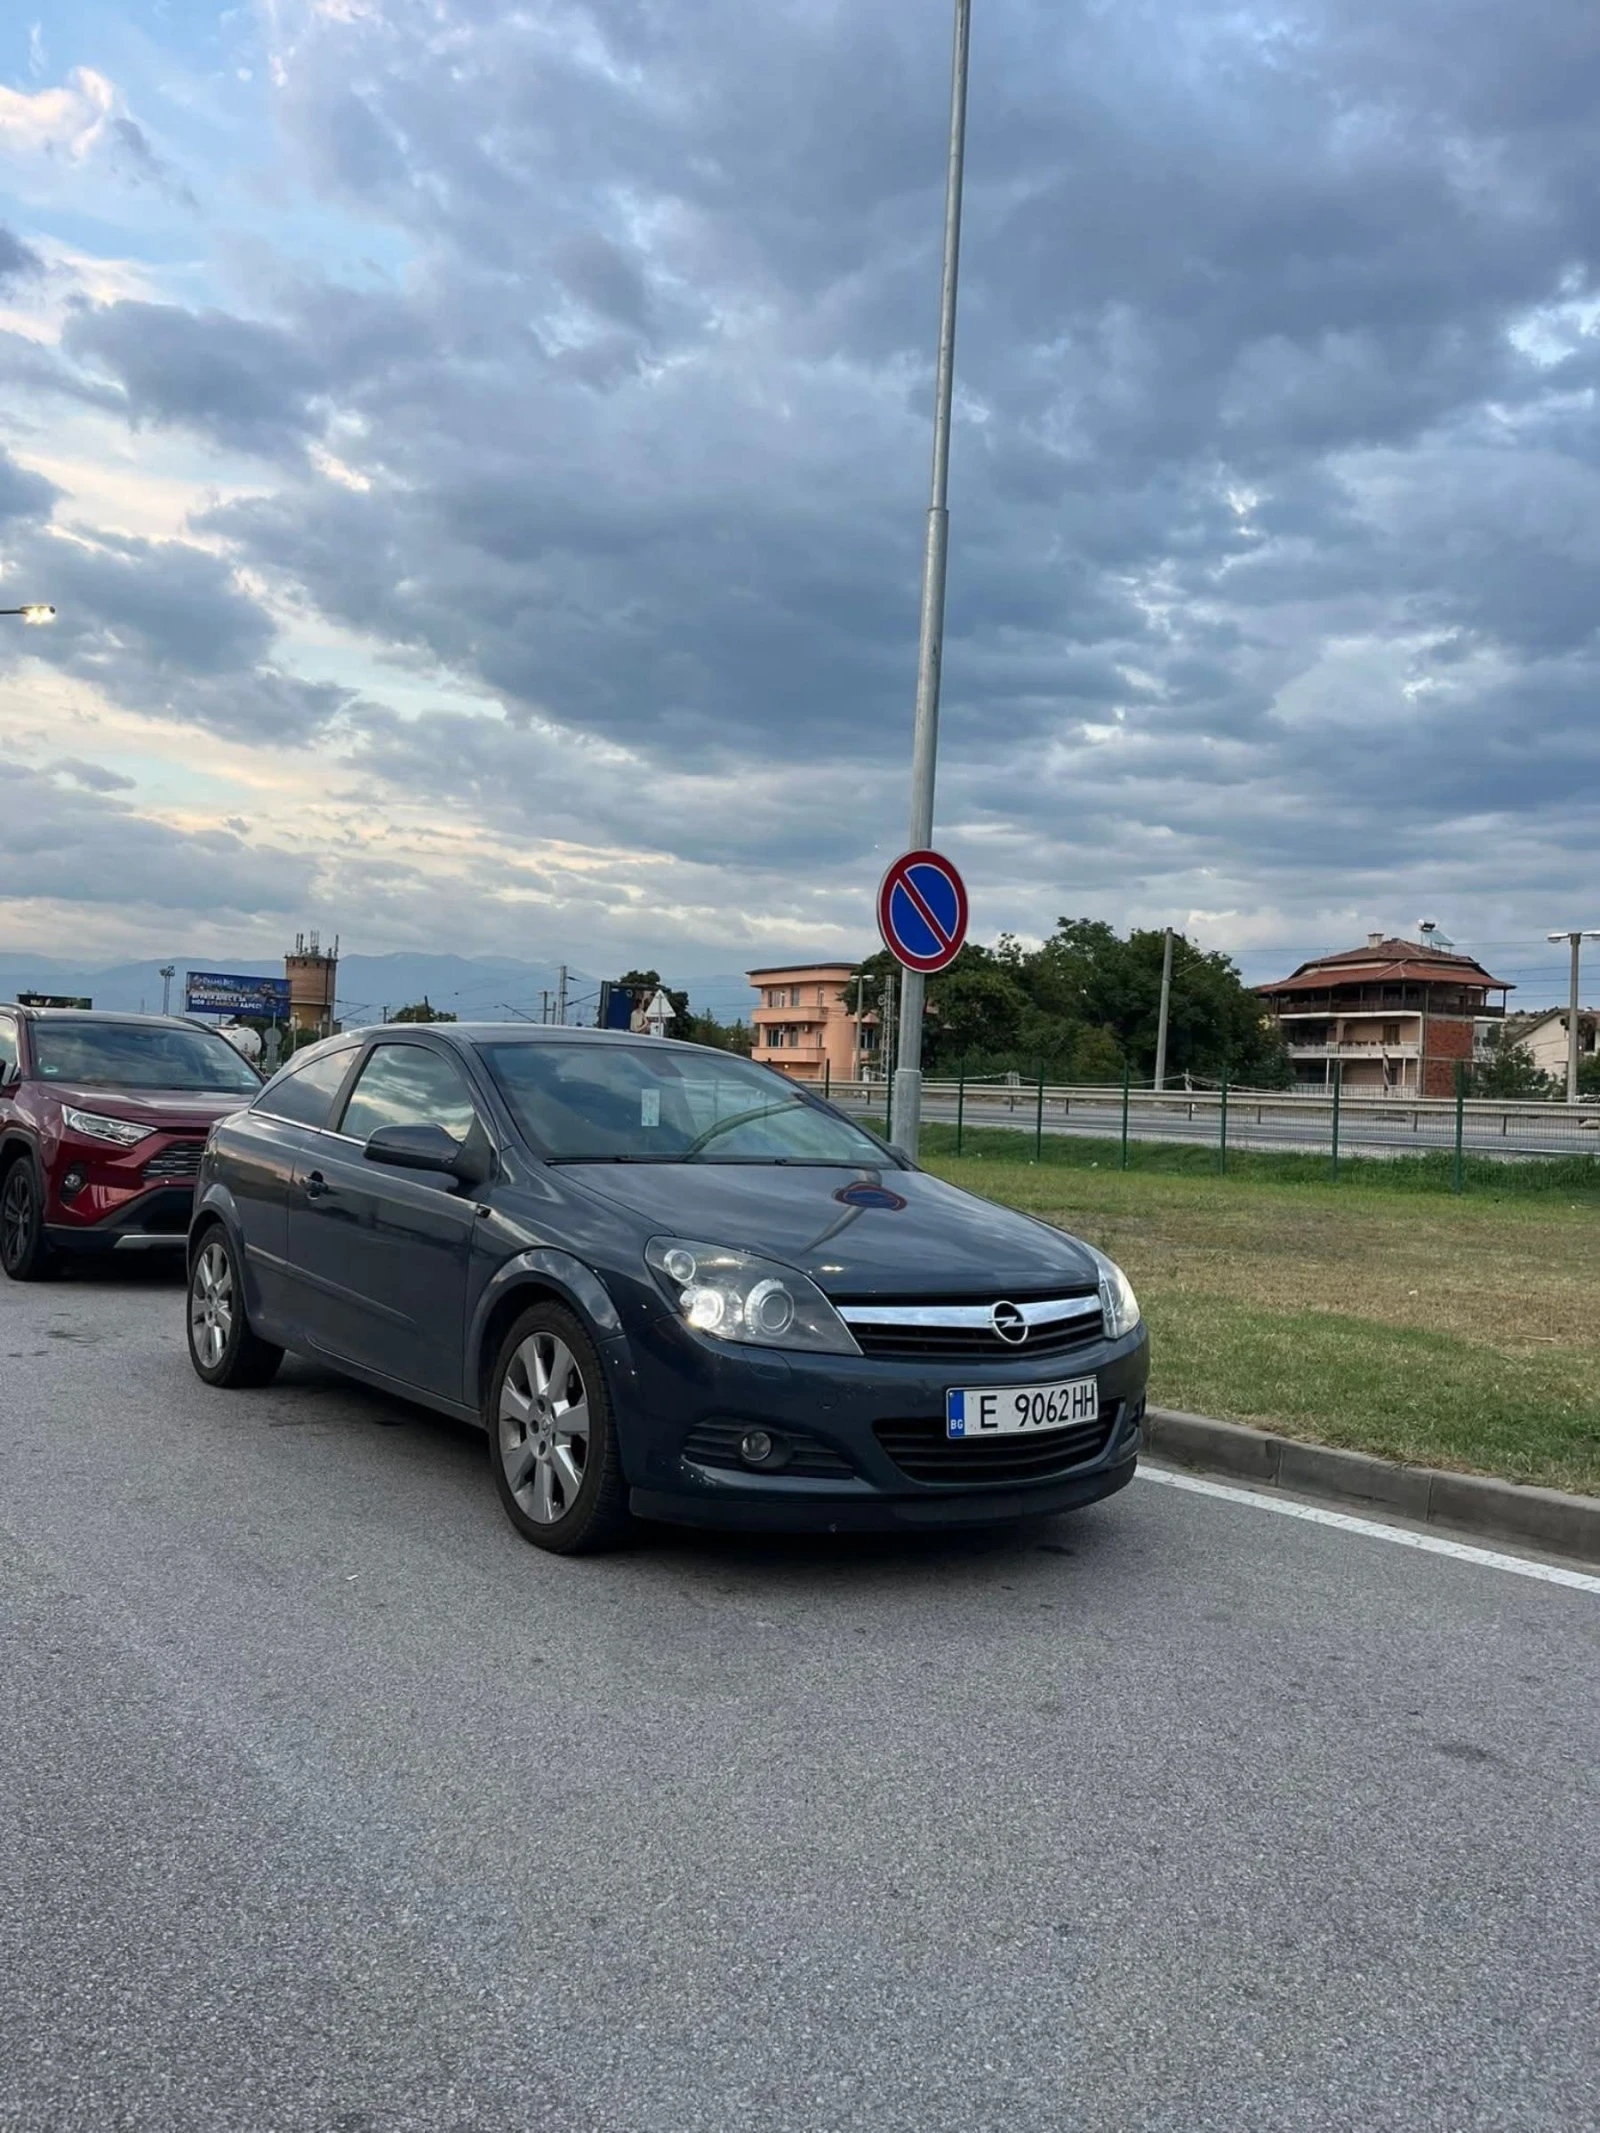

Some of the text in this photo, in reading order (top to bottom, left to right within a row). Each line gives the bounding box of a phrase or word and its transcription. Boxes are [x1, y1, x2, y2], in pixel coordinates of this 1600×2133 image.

[980, 1383, 1095, 1428] E 9062HH
[950, 1418, 964, 1430] BG
